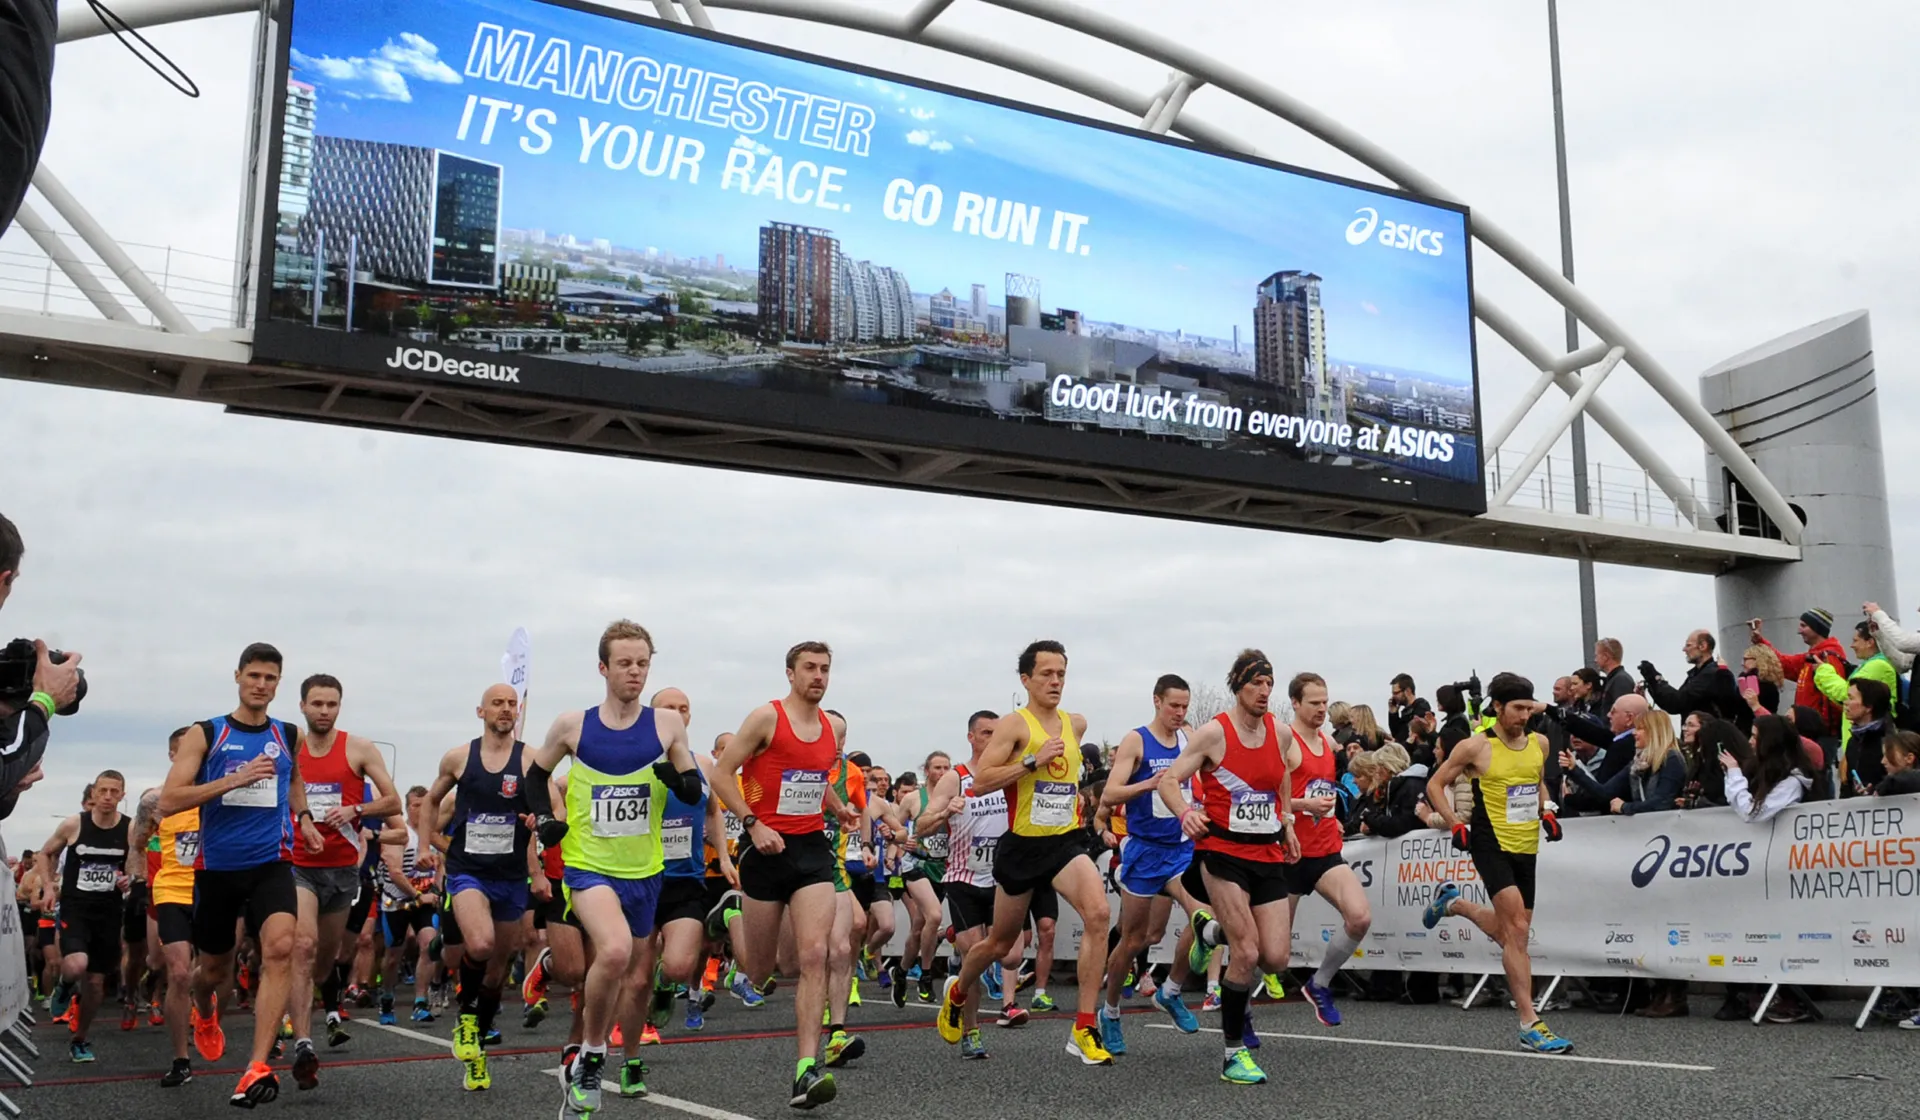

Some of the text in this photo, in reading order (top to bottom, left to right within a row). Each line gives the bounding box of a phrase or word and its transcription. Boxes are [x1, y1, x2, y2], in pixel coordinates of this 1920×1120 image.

[464, 22, 876, 157] MANCHESTER
[577, 117, 706, 184] YOUR
[721, 147, 852, 213] RACE.
[882, 178, 942, 227] GO
[953, 191, 1042, 246] RUN
[1048, 210, 1091, 256] IT.
[386, 346, 521, 384] JCDecaux
[1051, 374, 1454, 463] Good luck from everyone at ASICS
[784, 788, 823, 800] Crawley
[594, 799, 649, 823] 11634
[1236, 803, 1271, 821] 6340
[1794, 808, 1904, 841] GREATER
[83, 870, 114, 883] 3060
[1398, 860, 1483, 884] MANCHES
